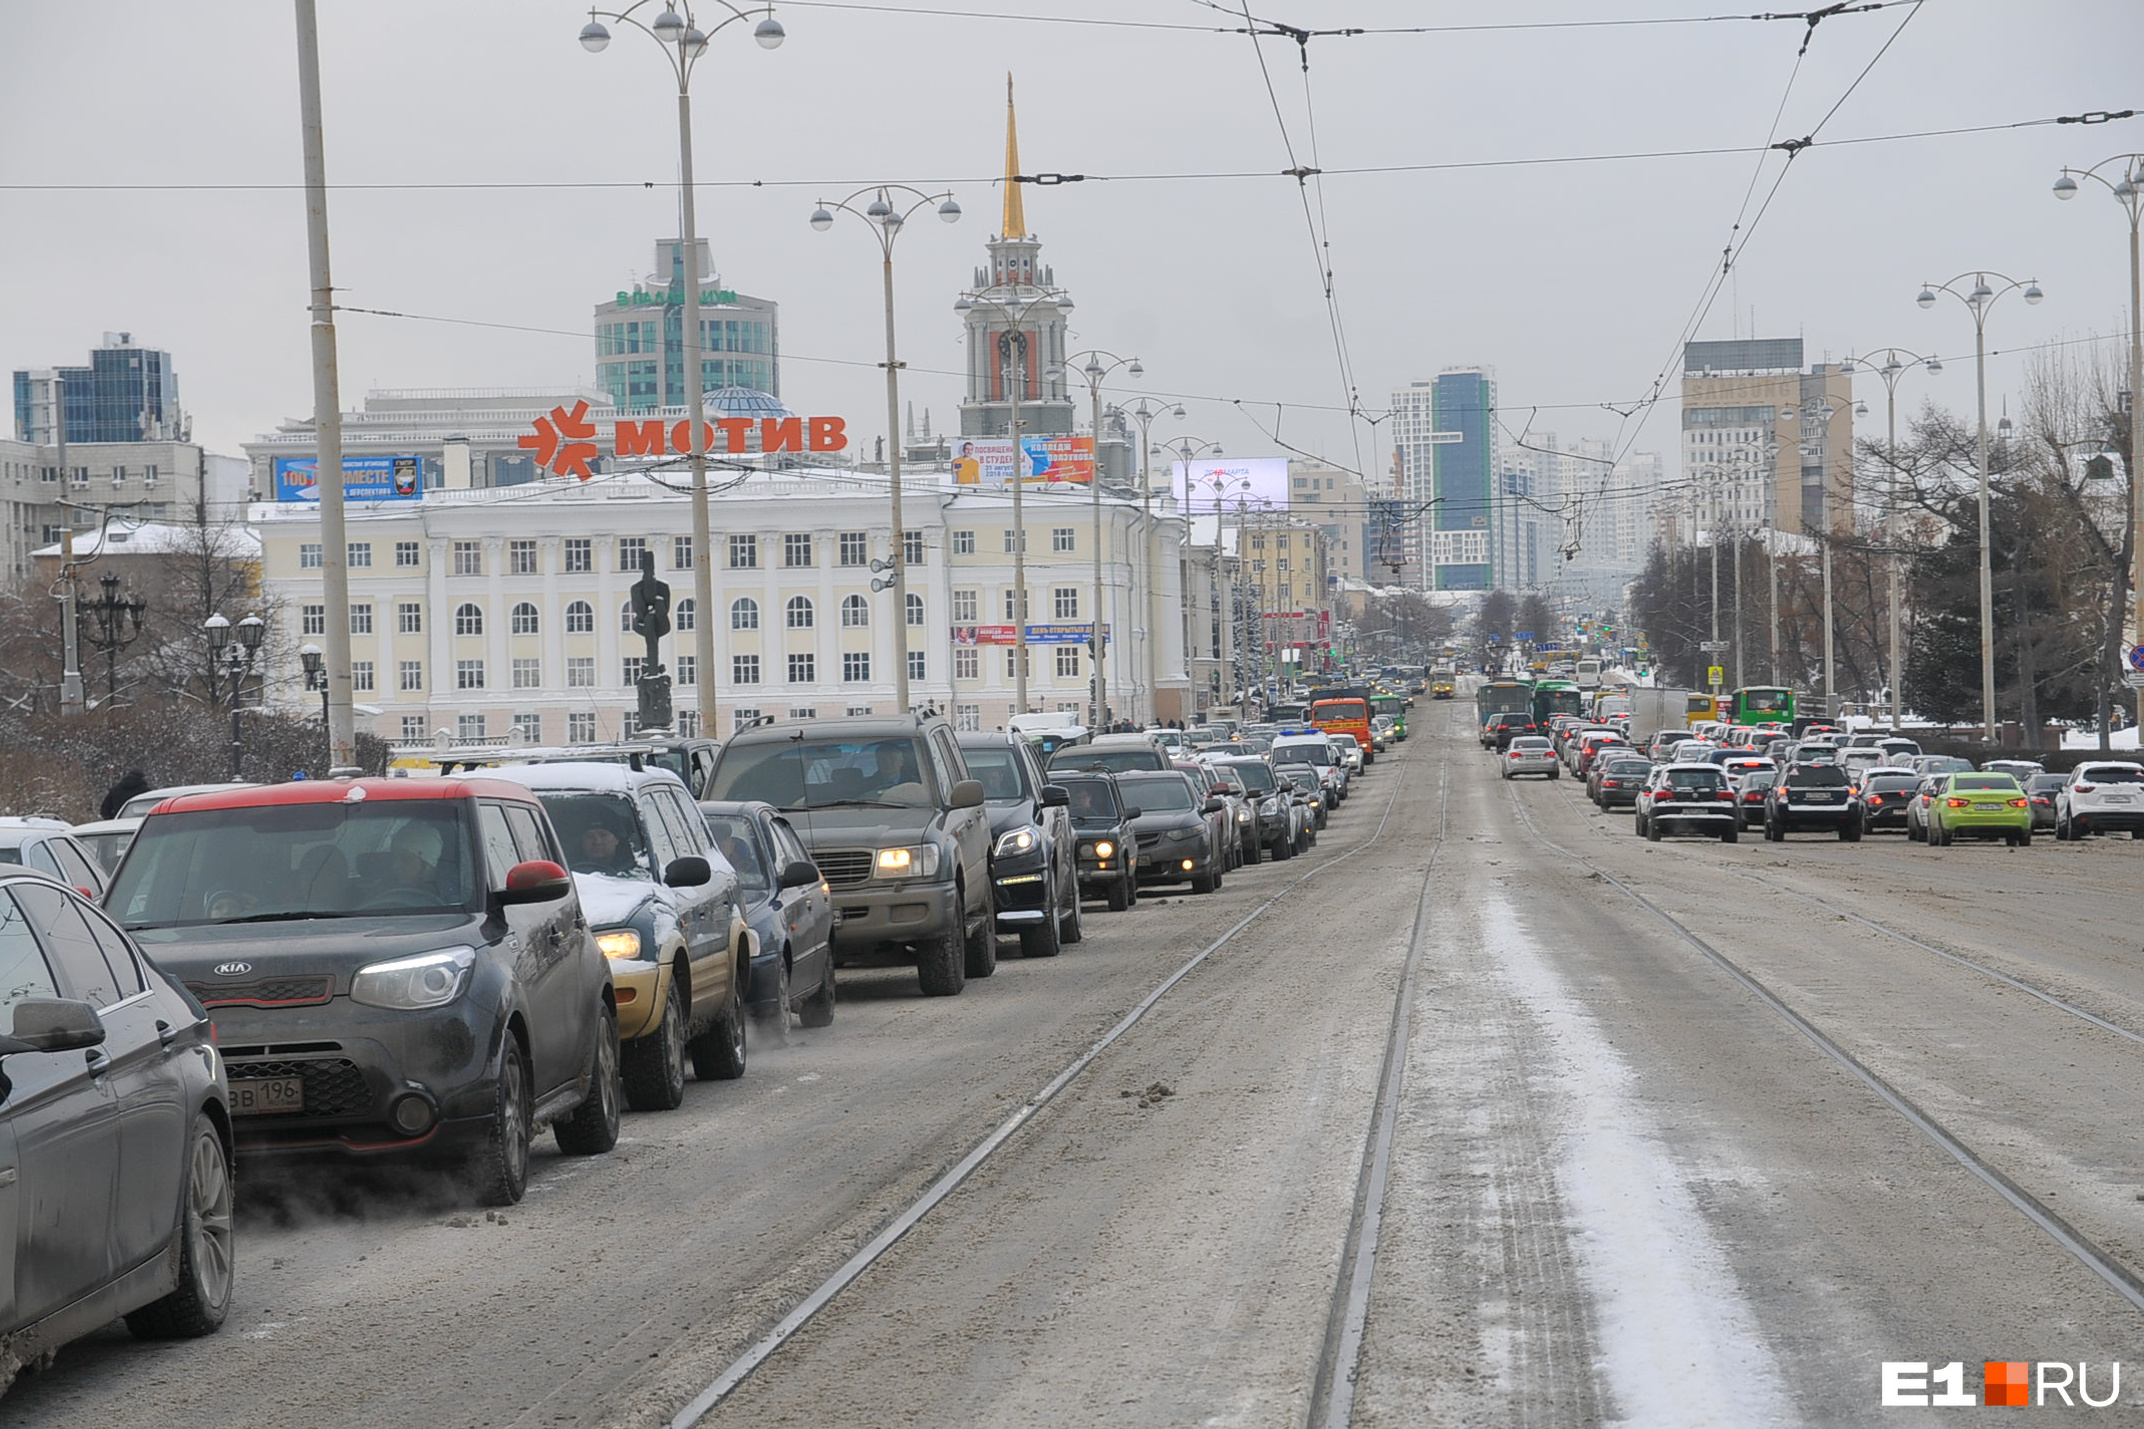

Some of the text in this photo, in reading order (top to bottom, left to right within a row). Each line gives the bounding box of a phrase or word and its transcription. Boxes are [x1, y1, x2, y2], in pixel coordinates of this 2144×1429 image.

[615, 416, 848, 456] МОТИВ
[282, 470, 307, 486] 100
[220, 963, 245, 973] KIA
[260, 1081, 295, 1099] 196
